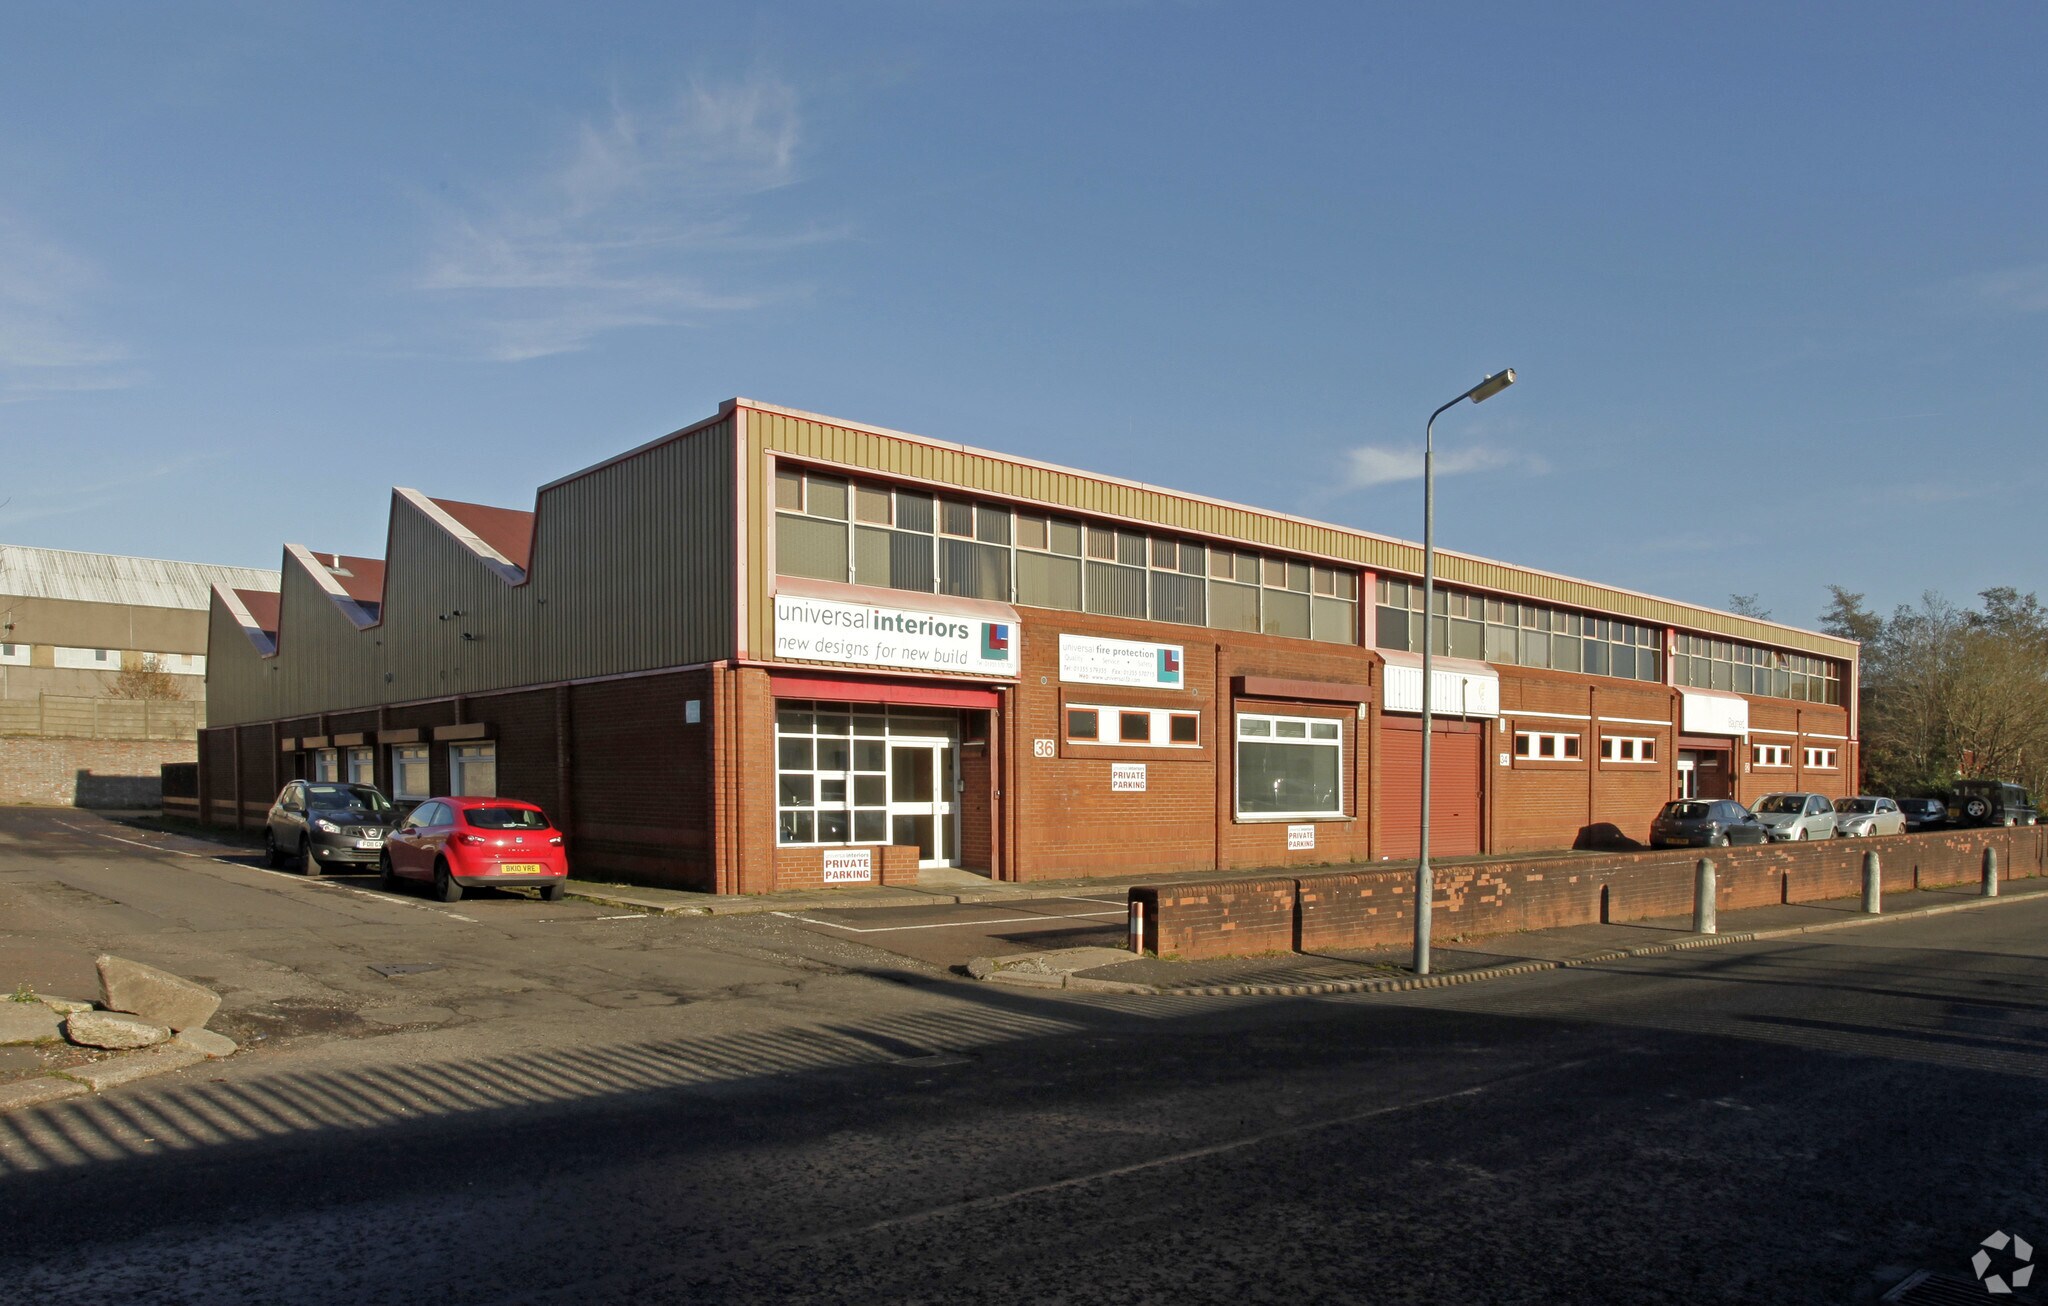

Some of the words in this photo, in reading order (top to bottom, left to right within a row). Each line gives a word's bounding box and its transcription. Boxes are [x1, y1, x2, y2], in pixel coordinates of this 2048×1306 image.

[778, 602, 870, 629] universal
[873, 609, 969, 640] interiors
[778, 636, 809, 650] new
[815, 636, 869, 658] designs
[875, 642, 897, 661] for
[902, 647, 930, 661] new
[934, 647, 968, 665] build
[1062, 643, 1095, 653] universal
[1096, 644, 1111, 655] fire
[1113, 647, 1155, 659] protection
[1064, 654, 1083, 662] Quality
[1102, 656, 1120, 665] Service
[1138, 660, 1153, 668] Safety
[1035, 740, 1054, 756] 36
[1500, 754, 1508, 764] 34
[1113, 771, 1145, 780] PRIVATE
[1113, 781, 1145, 789] PARKING
[505, 864, 522, 872] BK10
[523, 864, 536, 872] VRE
[825, 859, 869, 868] PRIVATE
[825, 869, 869, 879] PARKING
